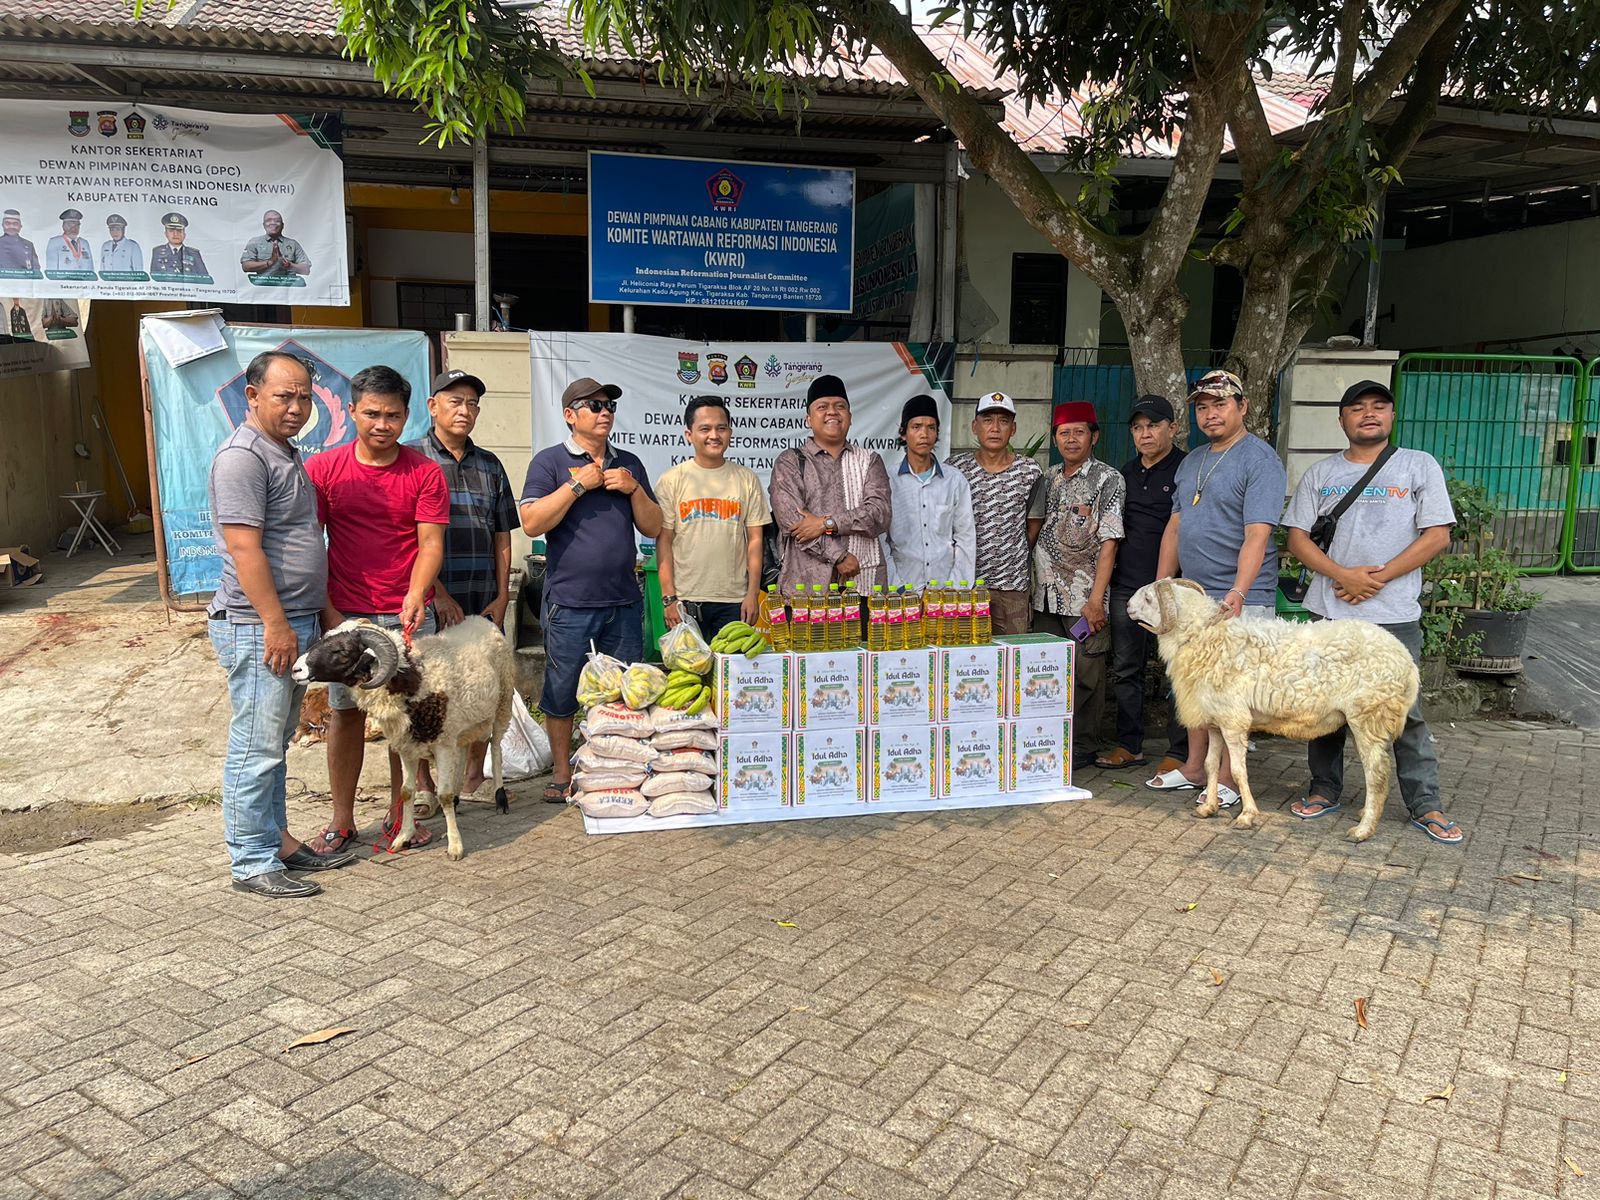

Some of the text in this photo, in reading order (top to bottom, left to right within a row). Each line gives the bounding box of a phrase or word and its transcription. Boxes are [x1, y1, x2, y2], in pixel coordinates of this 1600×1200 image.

[71, 145, 204, 158] KANTOR SEKERTARIAT
[39, 160, 241, 177] DEWAN PIMPINAN CABANG (DPC)
[0, 175, 295, 195] MITE WARTAWAN REFORMASI INDONESIA (KWRI)
[68, 192, 218, 206] KABUPATEN TANGERANG
[607, 211, 838, 234] DEWAN PIMPINAN CABANG KABUPATEN TANGERANG
[607, 227, 837, 253] KOMITE WARTAWAN REFORMASI INDONESIA
[704, 250, 745, 269] (KWRI)
[635, 267, 808, 281] Indonesian Reformation Journalist Committee
[669, 289, 689, 297] Agung
[706, 290, 735, 298] Tigaraksa
[751, 292, 781, 300] Tangerang
[784, 363, 823, 372] Tangerang
[680, 394, 808, 410] KAR SEKERTARIA
[607, 432, 636, 445] MITE
[640, 433, 692, 447] WARTA
[728, 436, 790, 449] EFORMASI
[179, 545, 217, 556] INDON
[956, 668, 989, 677] Idul Adha
[1042, 664, 1059, 672] Adha
[753, 676, 774, 684] Adha
[814, 674, 849, 683] Idul Adha
[886, 671, 920, 680] Idul Adha
[957, 743, 991, 752] Idul Adha
[1023, 739, 1056, 748] Idul Adha
[812, 751, 848, 761] Idul Adha
[887, 747, 922, 756] Idul Adha
[736, 755, 773, 764] Idul Adha
[599, 795, 634, 806] KEPALA
